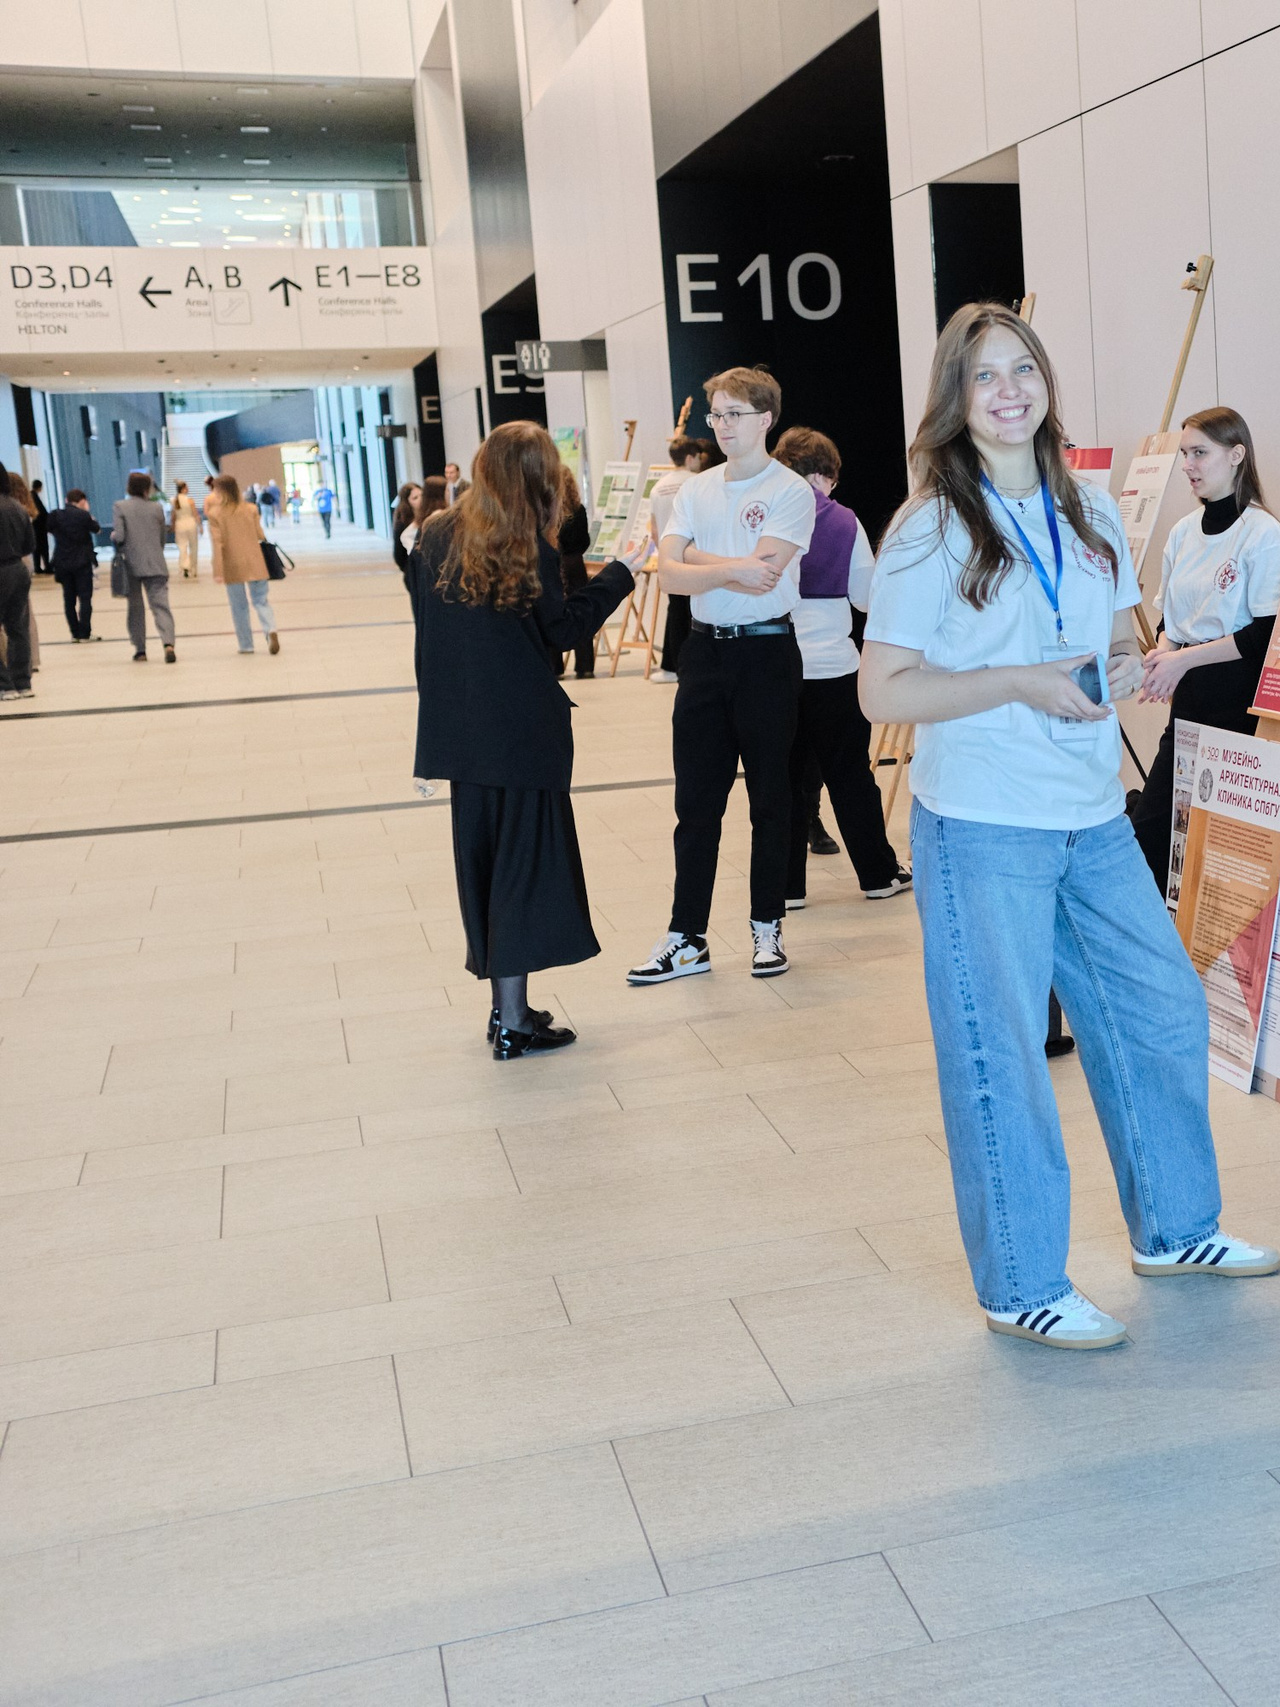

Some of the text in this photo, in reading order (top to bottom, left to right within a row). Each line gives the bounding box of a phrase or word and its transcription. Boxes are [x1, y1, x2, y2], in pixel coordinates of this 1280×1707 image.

[10, 265, 113, 293] D3,D4
[224, 266, 242, 288] B
[676, 252, 842, 323] E10
[15, 299, 103, 309] Conference Halls
[318, 297, 397, 306] Conference Halls
[18, 324, 68, 334] HILTON
[1221, 748, 1262, 770] МУЗЕЙНО-
[1216, 788, 1280, 818] КЛИНИКА СПбГУ
